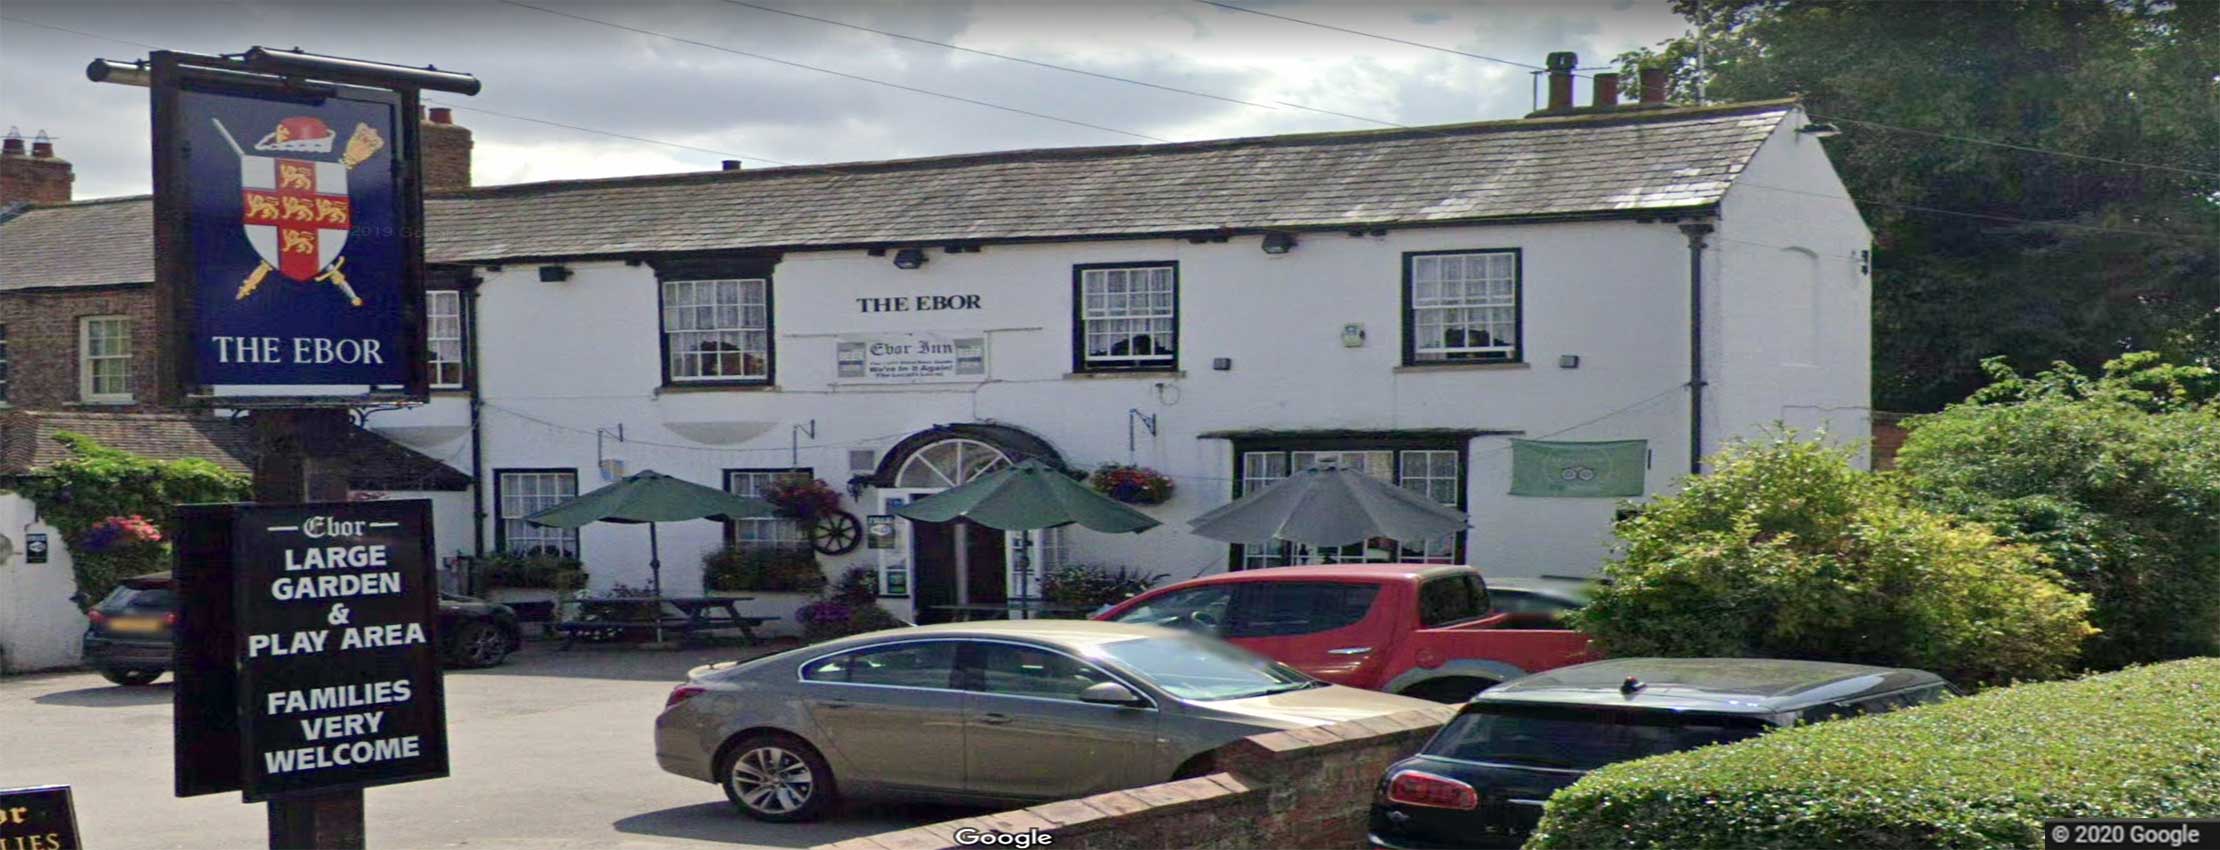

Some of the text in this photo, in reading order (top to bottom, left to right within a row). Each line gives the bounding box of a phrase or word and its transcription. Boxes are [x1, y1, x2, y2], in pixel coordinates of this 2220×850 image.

[856, 294, 981, 313] THE EBOR
[212, 336, 384, 364] THE EBOR
[870, 340, 953, 356] Ebor Inn
[303, 515, 366, 538] Ebor
[285, 545, 387, 571] LARGE
[271, 571, 401, 600] GARDEN
[328, 602, 350, 625] &
[248, 622, 426, 657] PLAY AREA
[267, 680, 411, 715] FAMILIES
[301, 711, 384, 741] VERY
[265, 735, 420, 774] WELCOME
